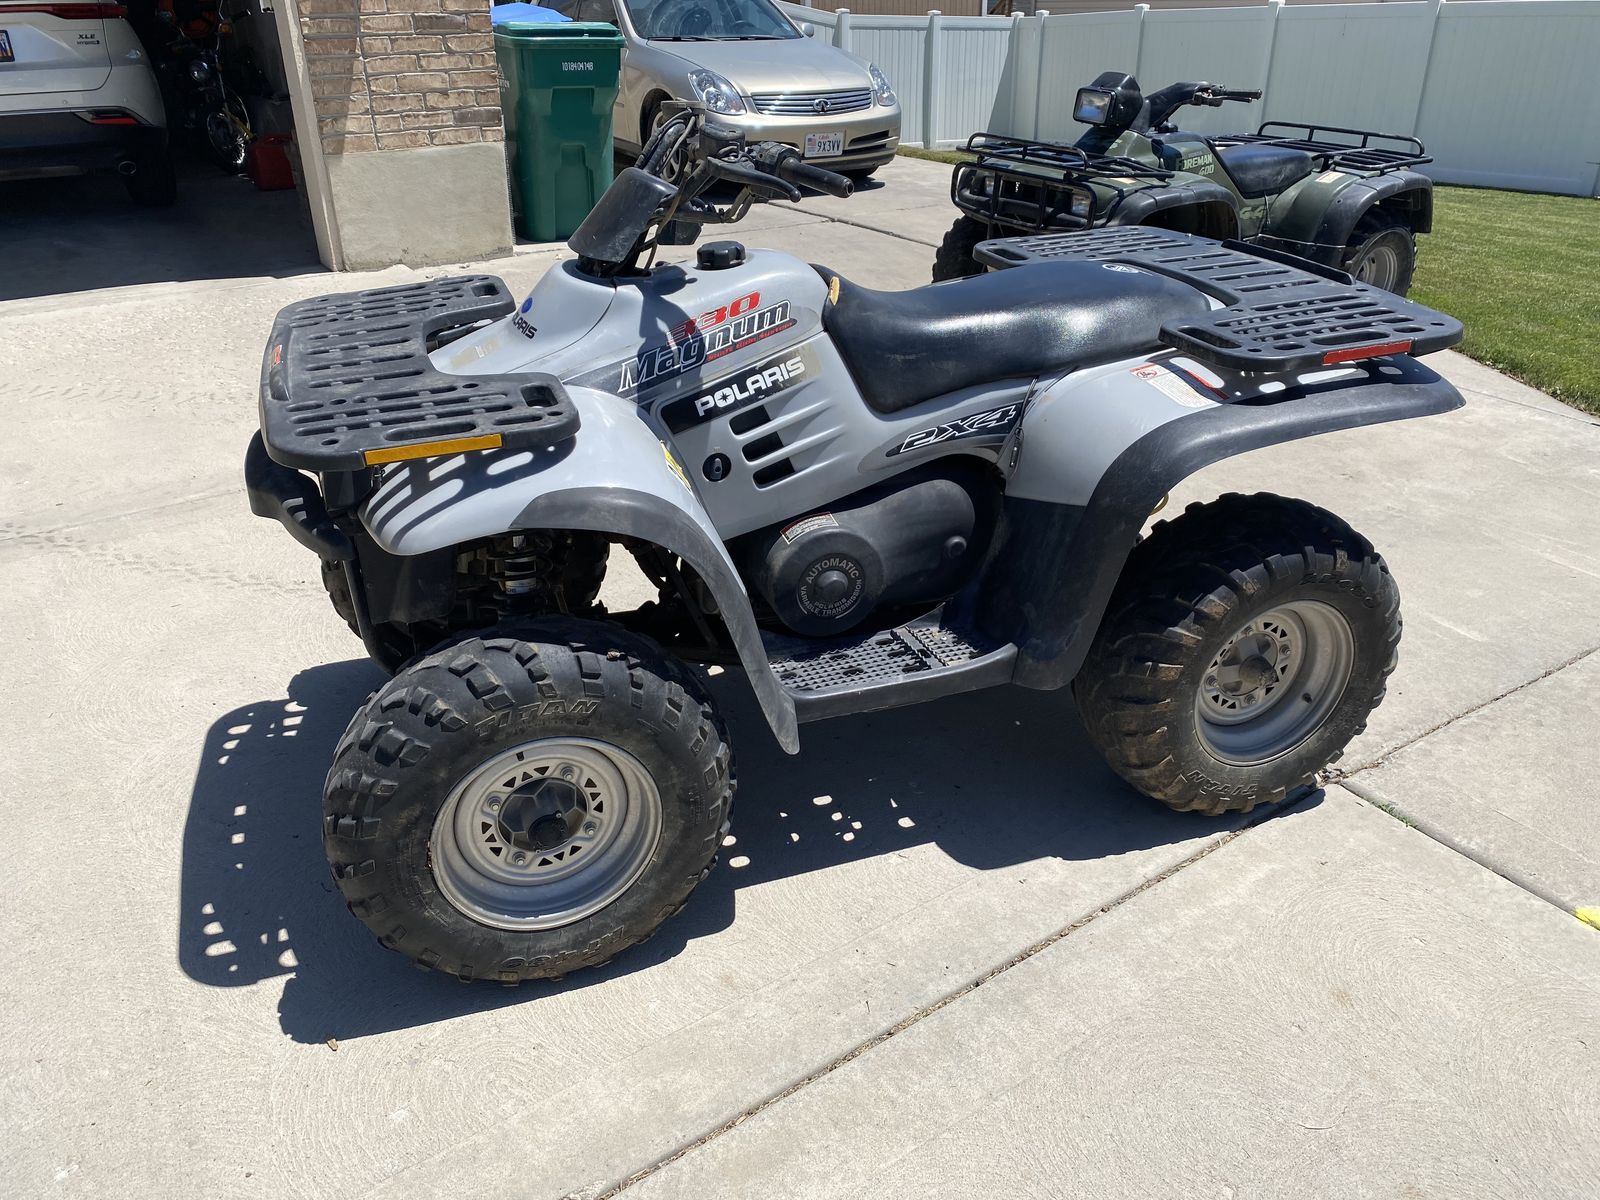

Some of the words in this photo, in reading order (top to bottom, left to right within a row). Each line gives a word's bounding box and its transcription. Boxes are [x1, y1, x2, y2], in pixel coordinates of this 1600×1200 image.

[667, 291, 761, 347] 330
[617, 300, 792, 393] Magnum
[694, 355, 806, 416] POLARIS
[806, 558, 859, 584] AUTOMATIC
[800, 585, 819, 614] VARIABLE
[822, 579, 862, 617] TRANSMISSION
[475, 699, 600, 737] TITAN
[1187, 769, 1258, 796] TITAN
